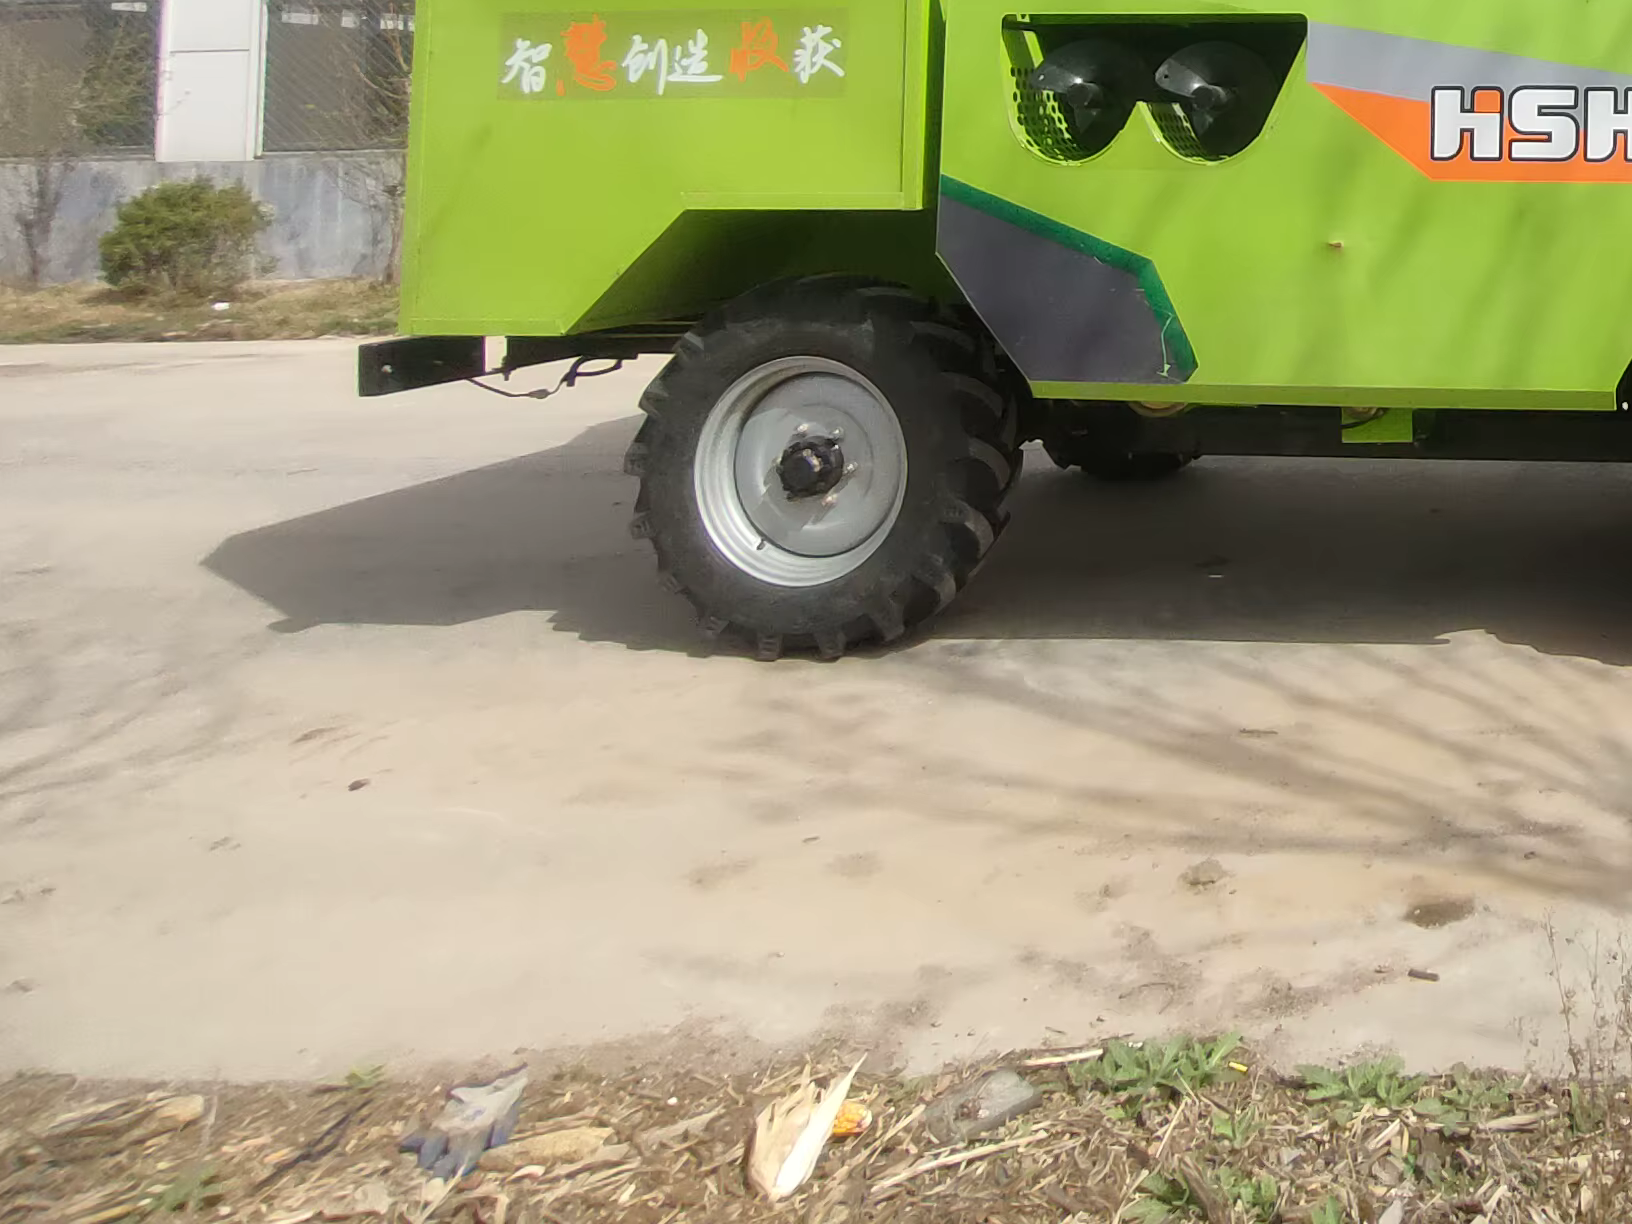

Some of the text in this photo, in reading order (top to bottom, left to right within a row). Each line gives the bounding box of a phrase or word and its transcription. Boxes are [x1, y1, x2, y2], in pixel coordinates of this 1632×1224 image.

[500, 14, 846, 96] 智慧创造收获
